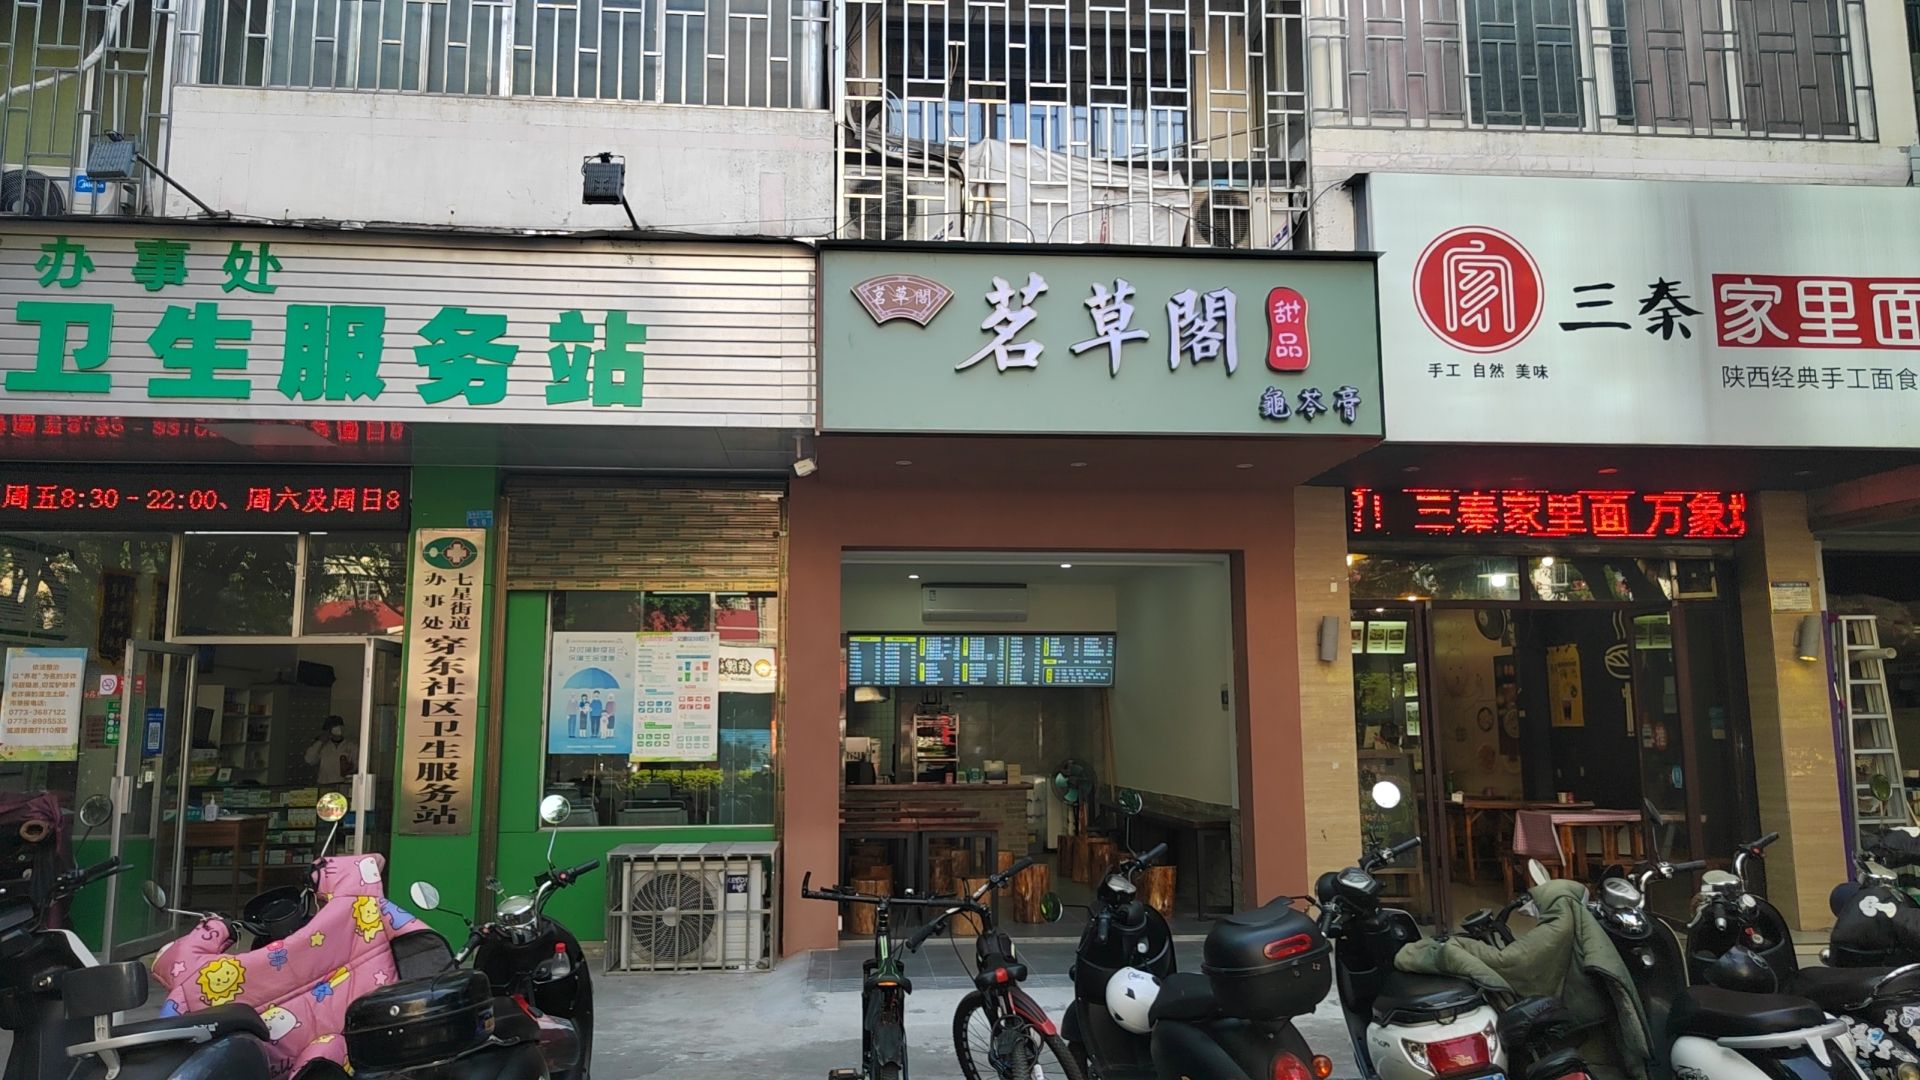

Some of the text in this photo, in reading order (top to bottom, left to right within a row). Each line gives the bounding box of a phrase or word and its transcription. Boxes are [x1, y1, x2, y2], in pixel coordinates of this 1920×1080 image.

[34, 236, 283, 294] 办事处
[870, 285, 934, 308] 茗草閣
[955, 271, 1238, 379] 茗草閣
[1558, 275, 1920, 345] 三秦 家里面
[5, 301, 647, 408] 卫生服务站
[1273, 298, 1303, 359] 甜品
[1427, 361, 1550, 381] 手工 自然 美味
[1721, 364, 1919, 392] 陕西经典手工面食
[421, 571, 447, 631] 办事处
[449, 571, 475, 631] 七星街道
